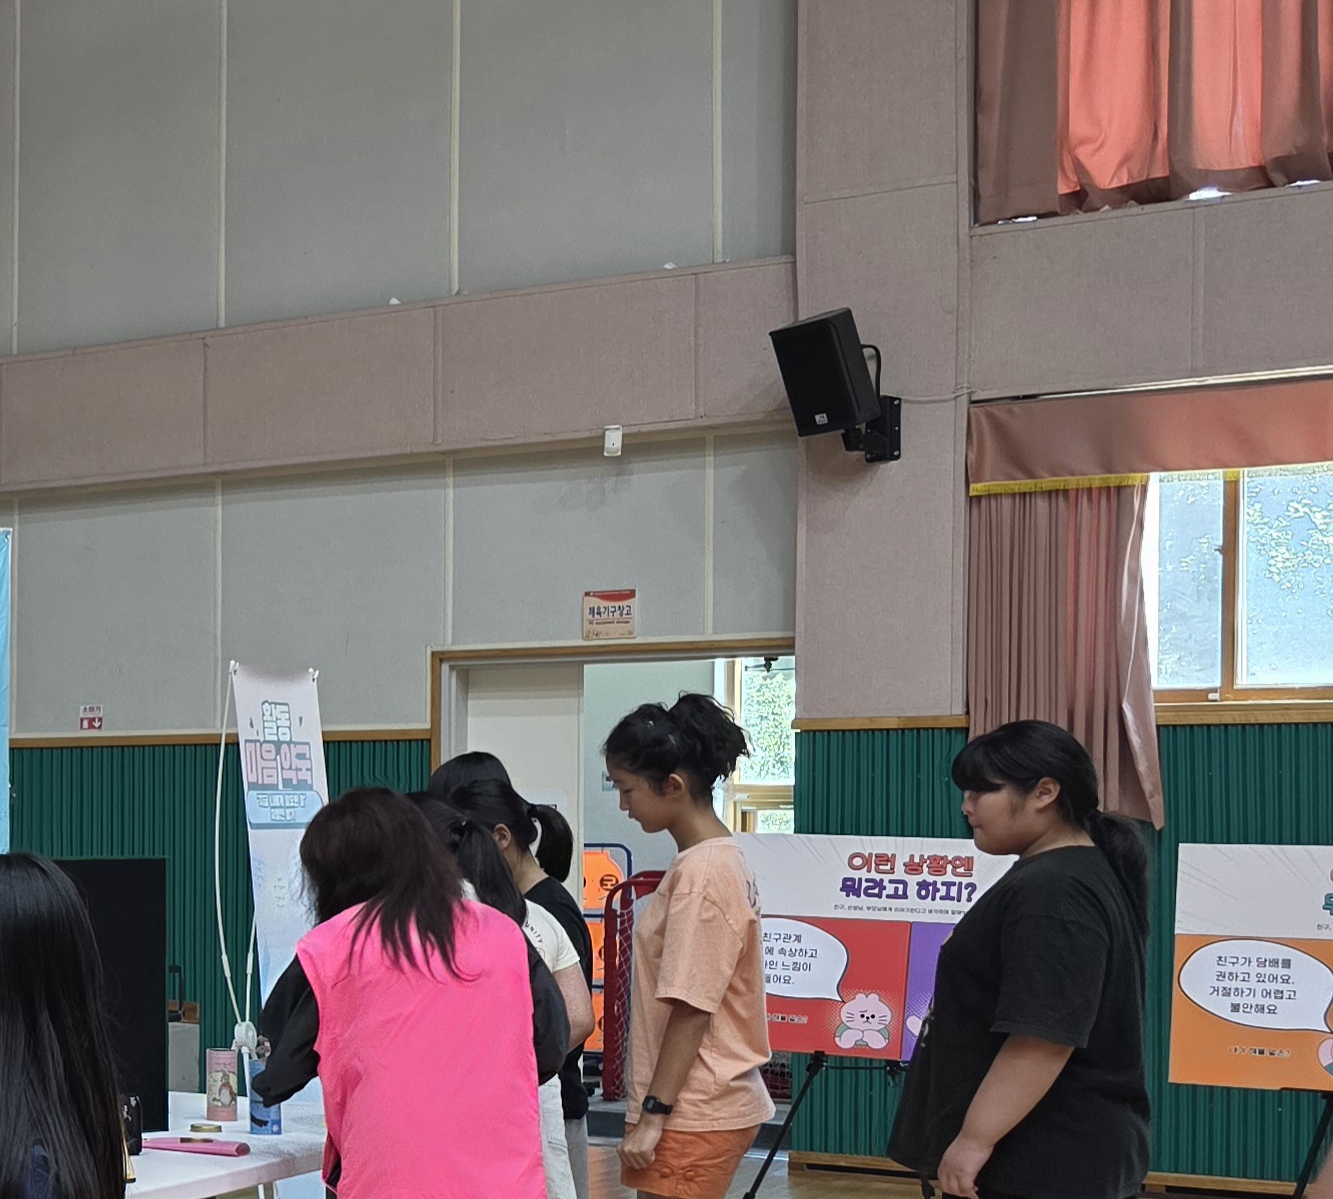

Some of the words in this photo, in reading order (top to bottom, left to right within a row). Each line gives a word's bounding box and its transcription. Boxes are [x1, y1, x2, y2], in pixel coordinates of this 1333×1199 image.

[588, 605, 632, 618] 체육기구창고
[847, 852, 896, 874] 이런
[903, 854, 974, 877] 상황엔
[840, 877, 909, 900] 뭐라고
[916, 879, 977, 902] 하지?
[778, 947, 818, 958] 속상하고
[781, 961, 812, 972] 느낌이
[1216, 956, 1252, 968] 친구가
[1256, 957, 1292, 969] 담배를
[1215, 971, 1251, 983] 권하고
[1255, 972, 1295, 985] 있어요.
[1208, 986, 1256, 998] 거절하기
[1261, 988, 1297, 1000] 어렵고
[1229, 1002, 1278, 1015] 불안해요
